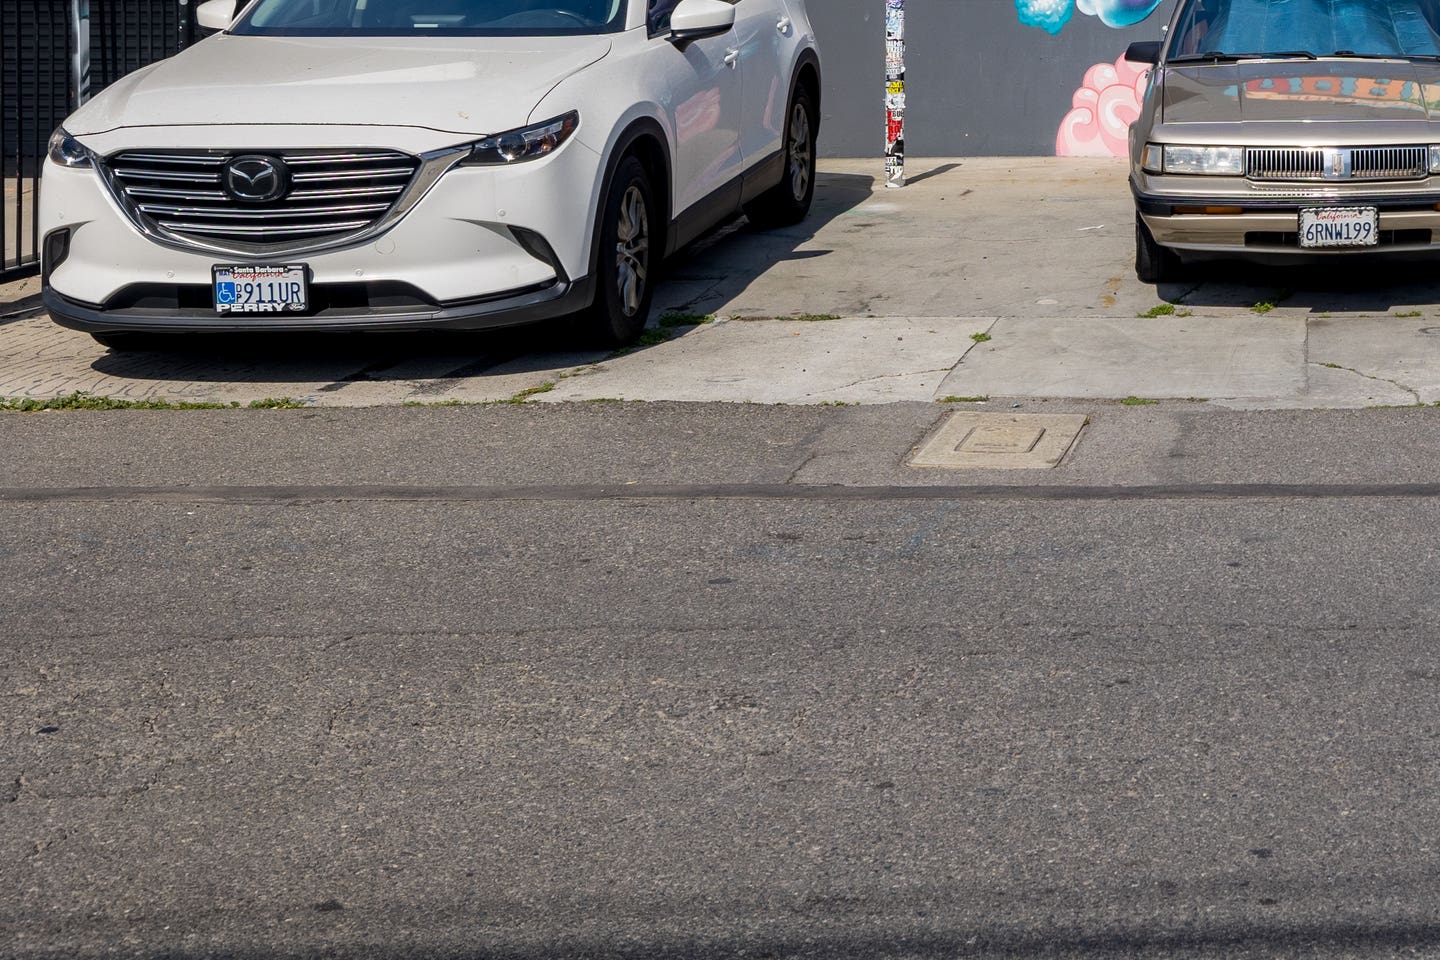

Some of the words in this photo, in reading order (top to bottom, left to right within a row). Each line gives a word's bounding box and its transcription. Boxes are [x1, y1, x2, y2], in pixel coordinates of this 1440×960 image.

[1315, 211, 1360, 222] California
[1306, 222, 1372, 241] 6RNW199
[255, 265, 284, 273] Barbara
[216, 303, 286, 312] PERRY
